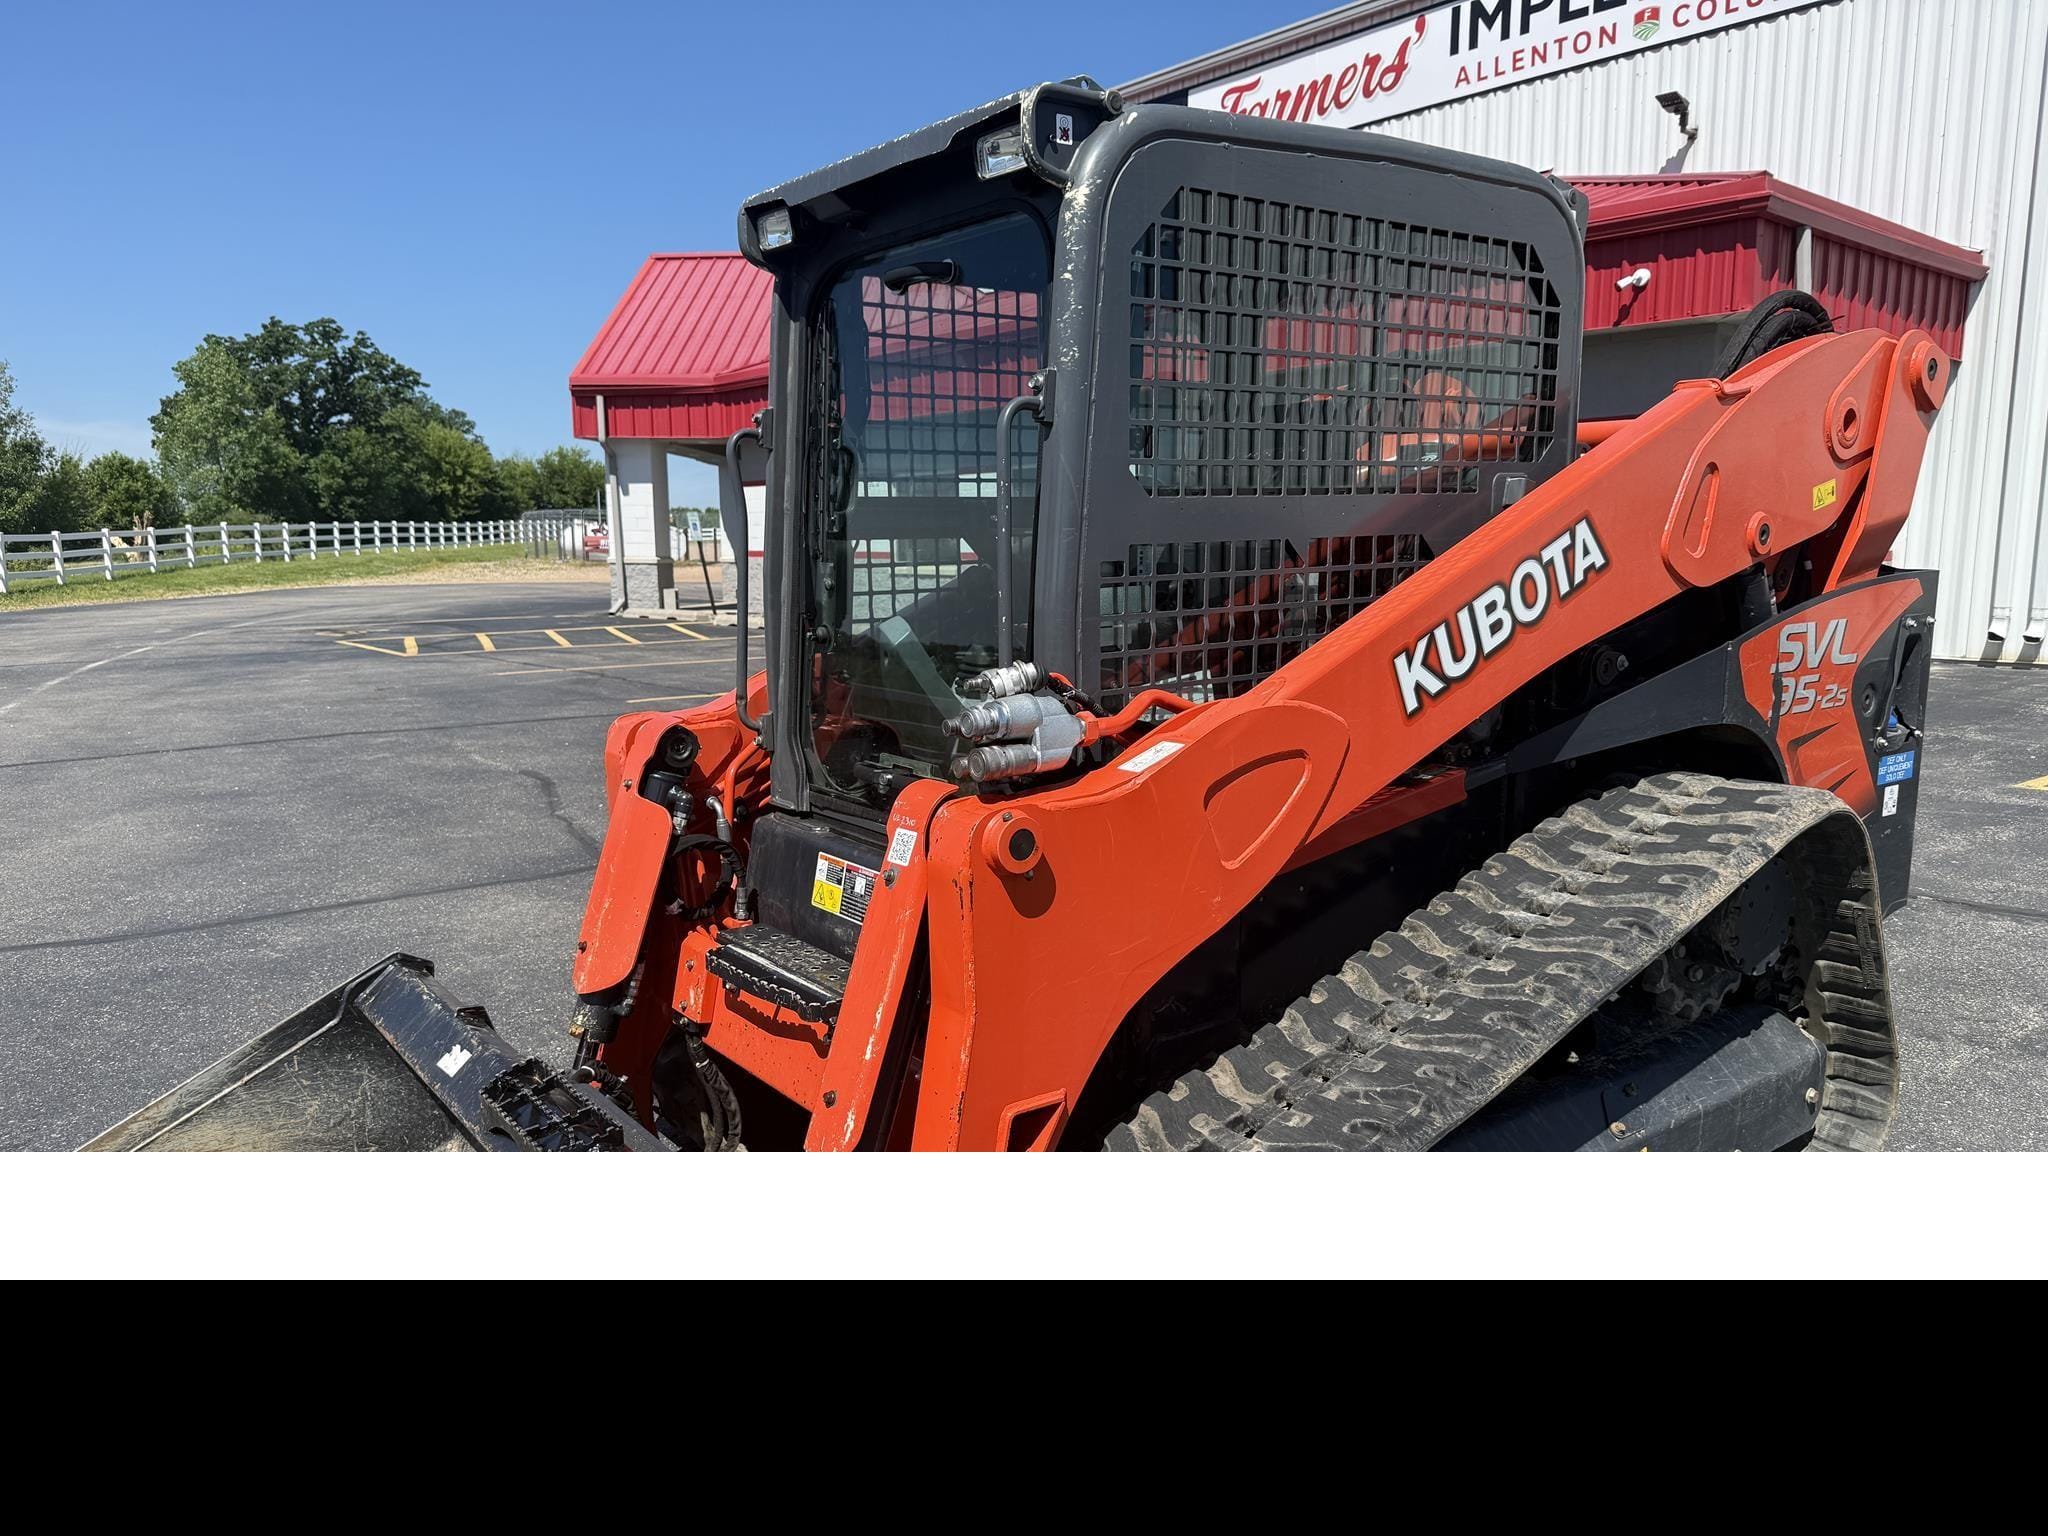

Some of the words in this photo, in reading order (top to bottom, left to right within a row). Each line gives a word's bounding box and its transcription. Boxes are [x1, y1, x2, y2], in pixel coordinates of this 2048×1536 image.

[1454, 22, 1617, 88] ALLENTON
[1392, 518, 1607, 716] KUBOTA
[1770, 618, 1858, 674] SVL
